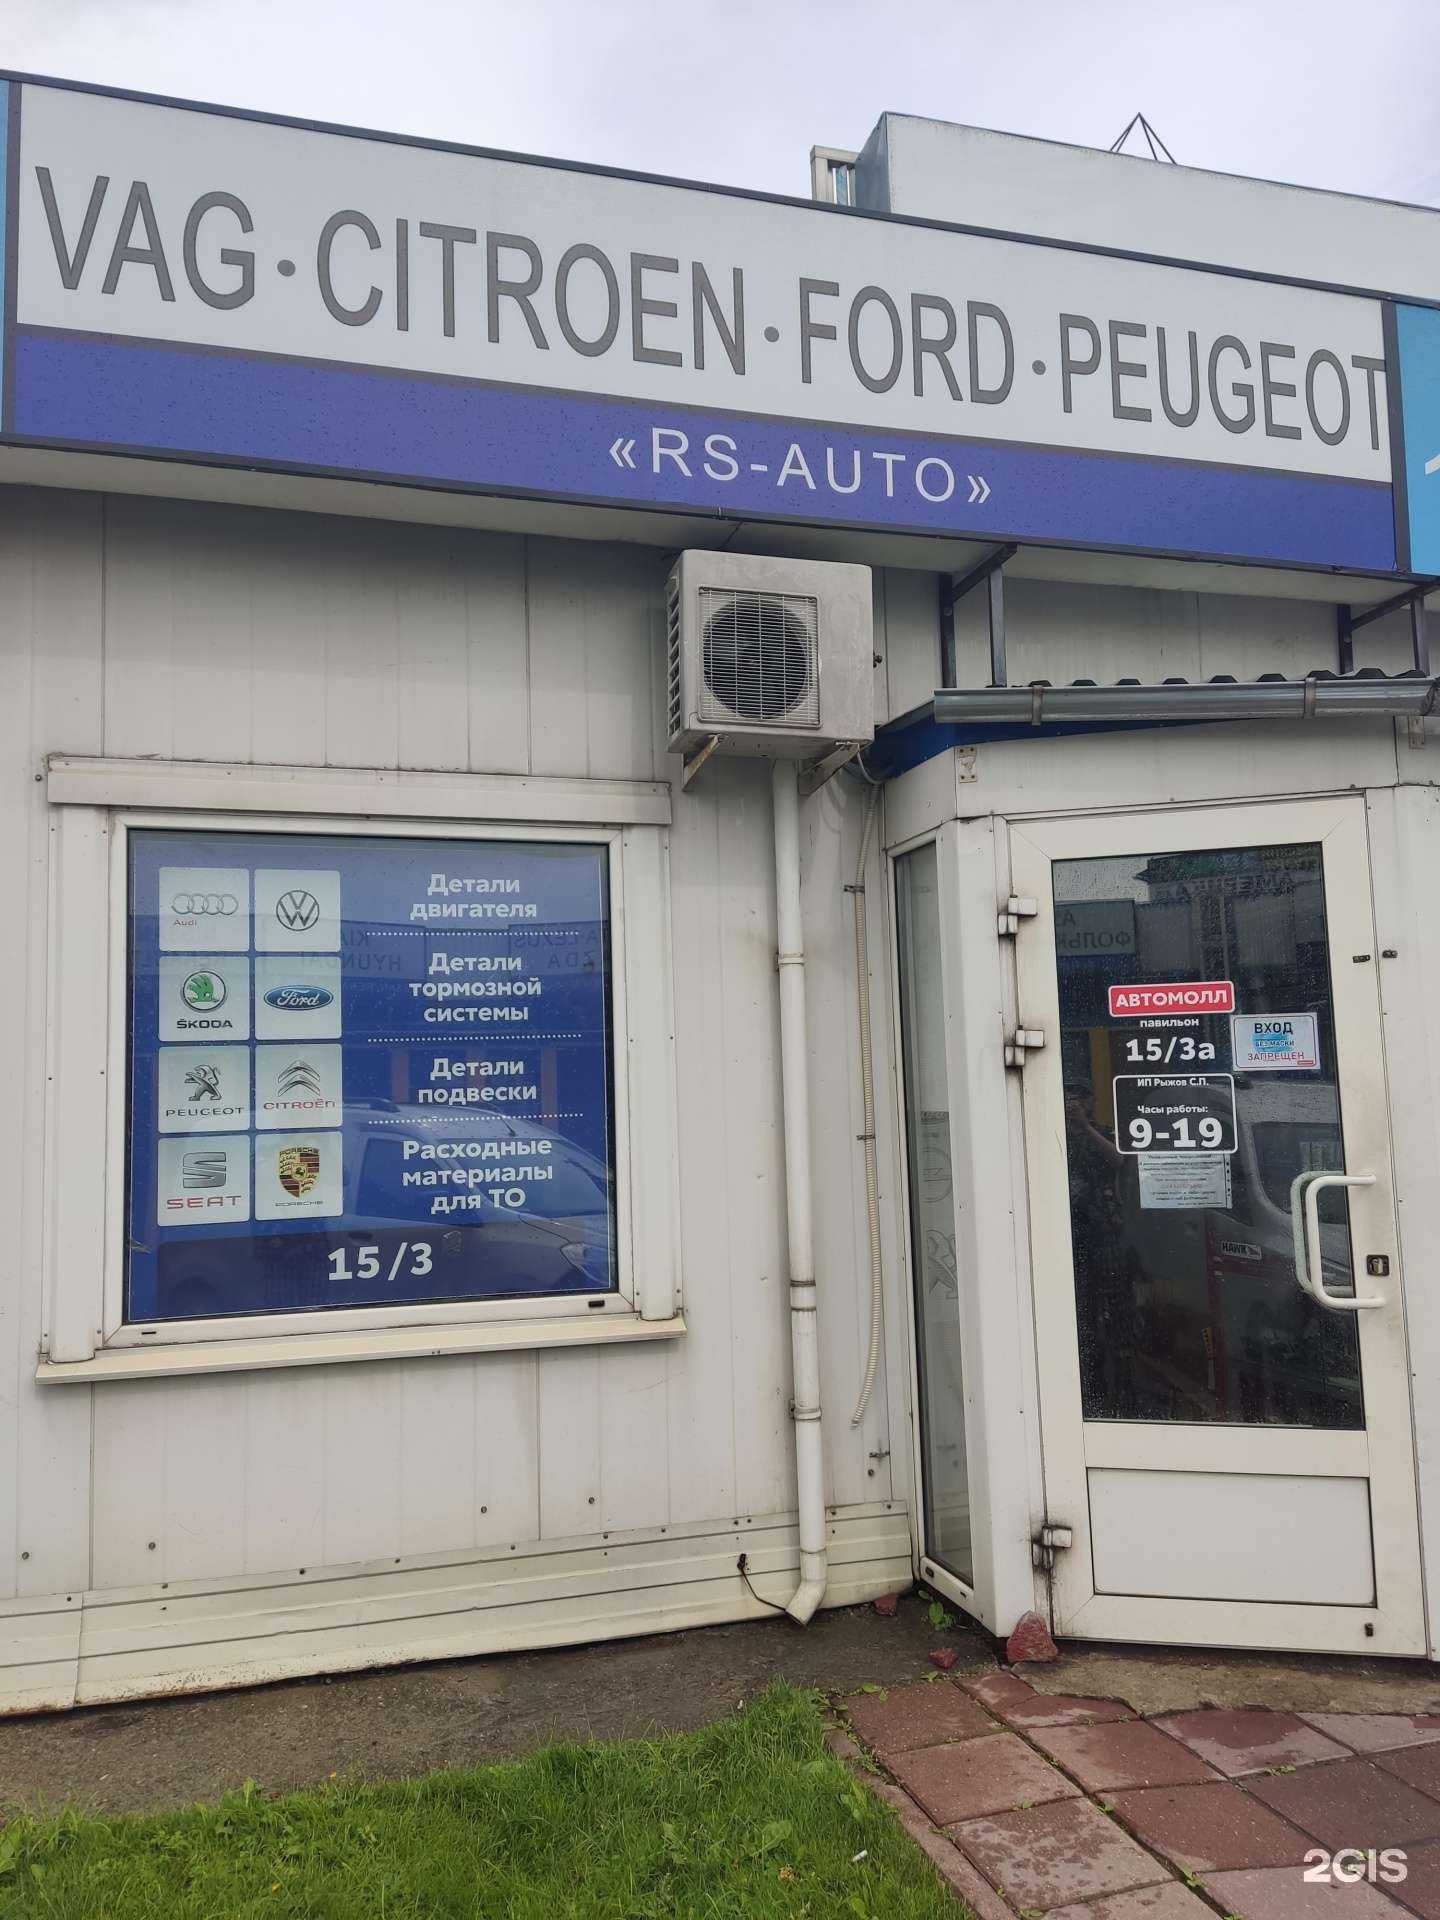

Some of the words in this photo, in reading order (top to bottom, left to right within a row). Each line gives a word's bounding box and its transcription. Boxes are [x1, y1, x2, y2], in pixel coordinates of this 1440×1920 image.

[35, 166, 255, 310] VAG
[317, 209, 746, 376] CITROEN
[799, 277, 1014, 405] FORD
[1060, 313, 1387, 450] PEUGEOT
[427, 874, 520, 896] Детали
[410, 902, 537, 920] двигателя
[173, 919, 197, 927] Audi
[429, 953, 522, 975] Детали
[277, 986, 320, 1006] Ford
[409, 977, 542, 1001] тормозной
[1115, 990, 1227, 1008] АВТОМОЛЛ
[424, 1006, 528, 1023] системы
[1140, 1018, 1199, 1028] павильон
[176, 1019, 233, 1029] ŠKODA
[1254, 1022, 1294, 1034] ВХОД
[1247, 1051, 1304, 1061] ЗАПРЕЩЕН
[430, 1058, 524, 1080] Детали
[1137, 1078, 1152, 1087] ИП
[1154, 1078, 1187, 1087] Рыжов
[1189, 1077, 1209, 1086] С.П.
[418, 1084, 537, 1105] подвески
[165, 1107, 245, 1117] PEUGEOT
[1137, 1105, 1164, 1114] Часы
[1166, 1105, 1208, 1115] работы:
[1128, 1117, 1223, 1148] 9-19
[403, 1140, 552, 1160] Расходные
[402, 1165, 552, 1188] материалы
[166, 1195, 242, 1210] SEAT
[430, 1194, 481, 1215] для
[488, 1188, 526, 1208] ТО
